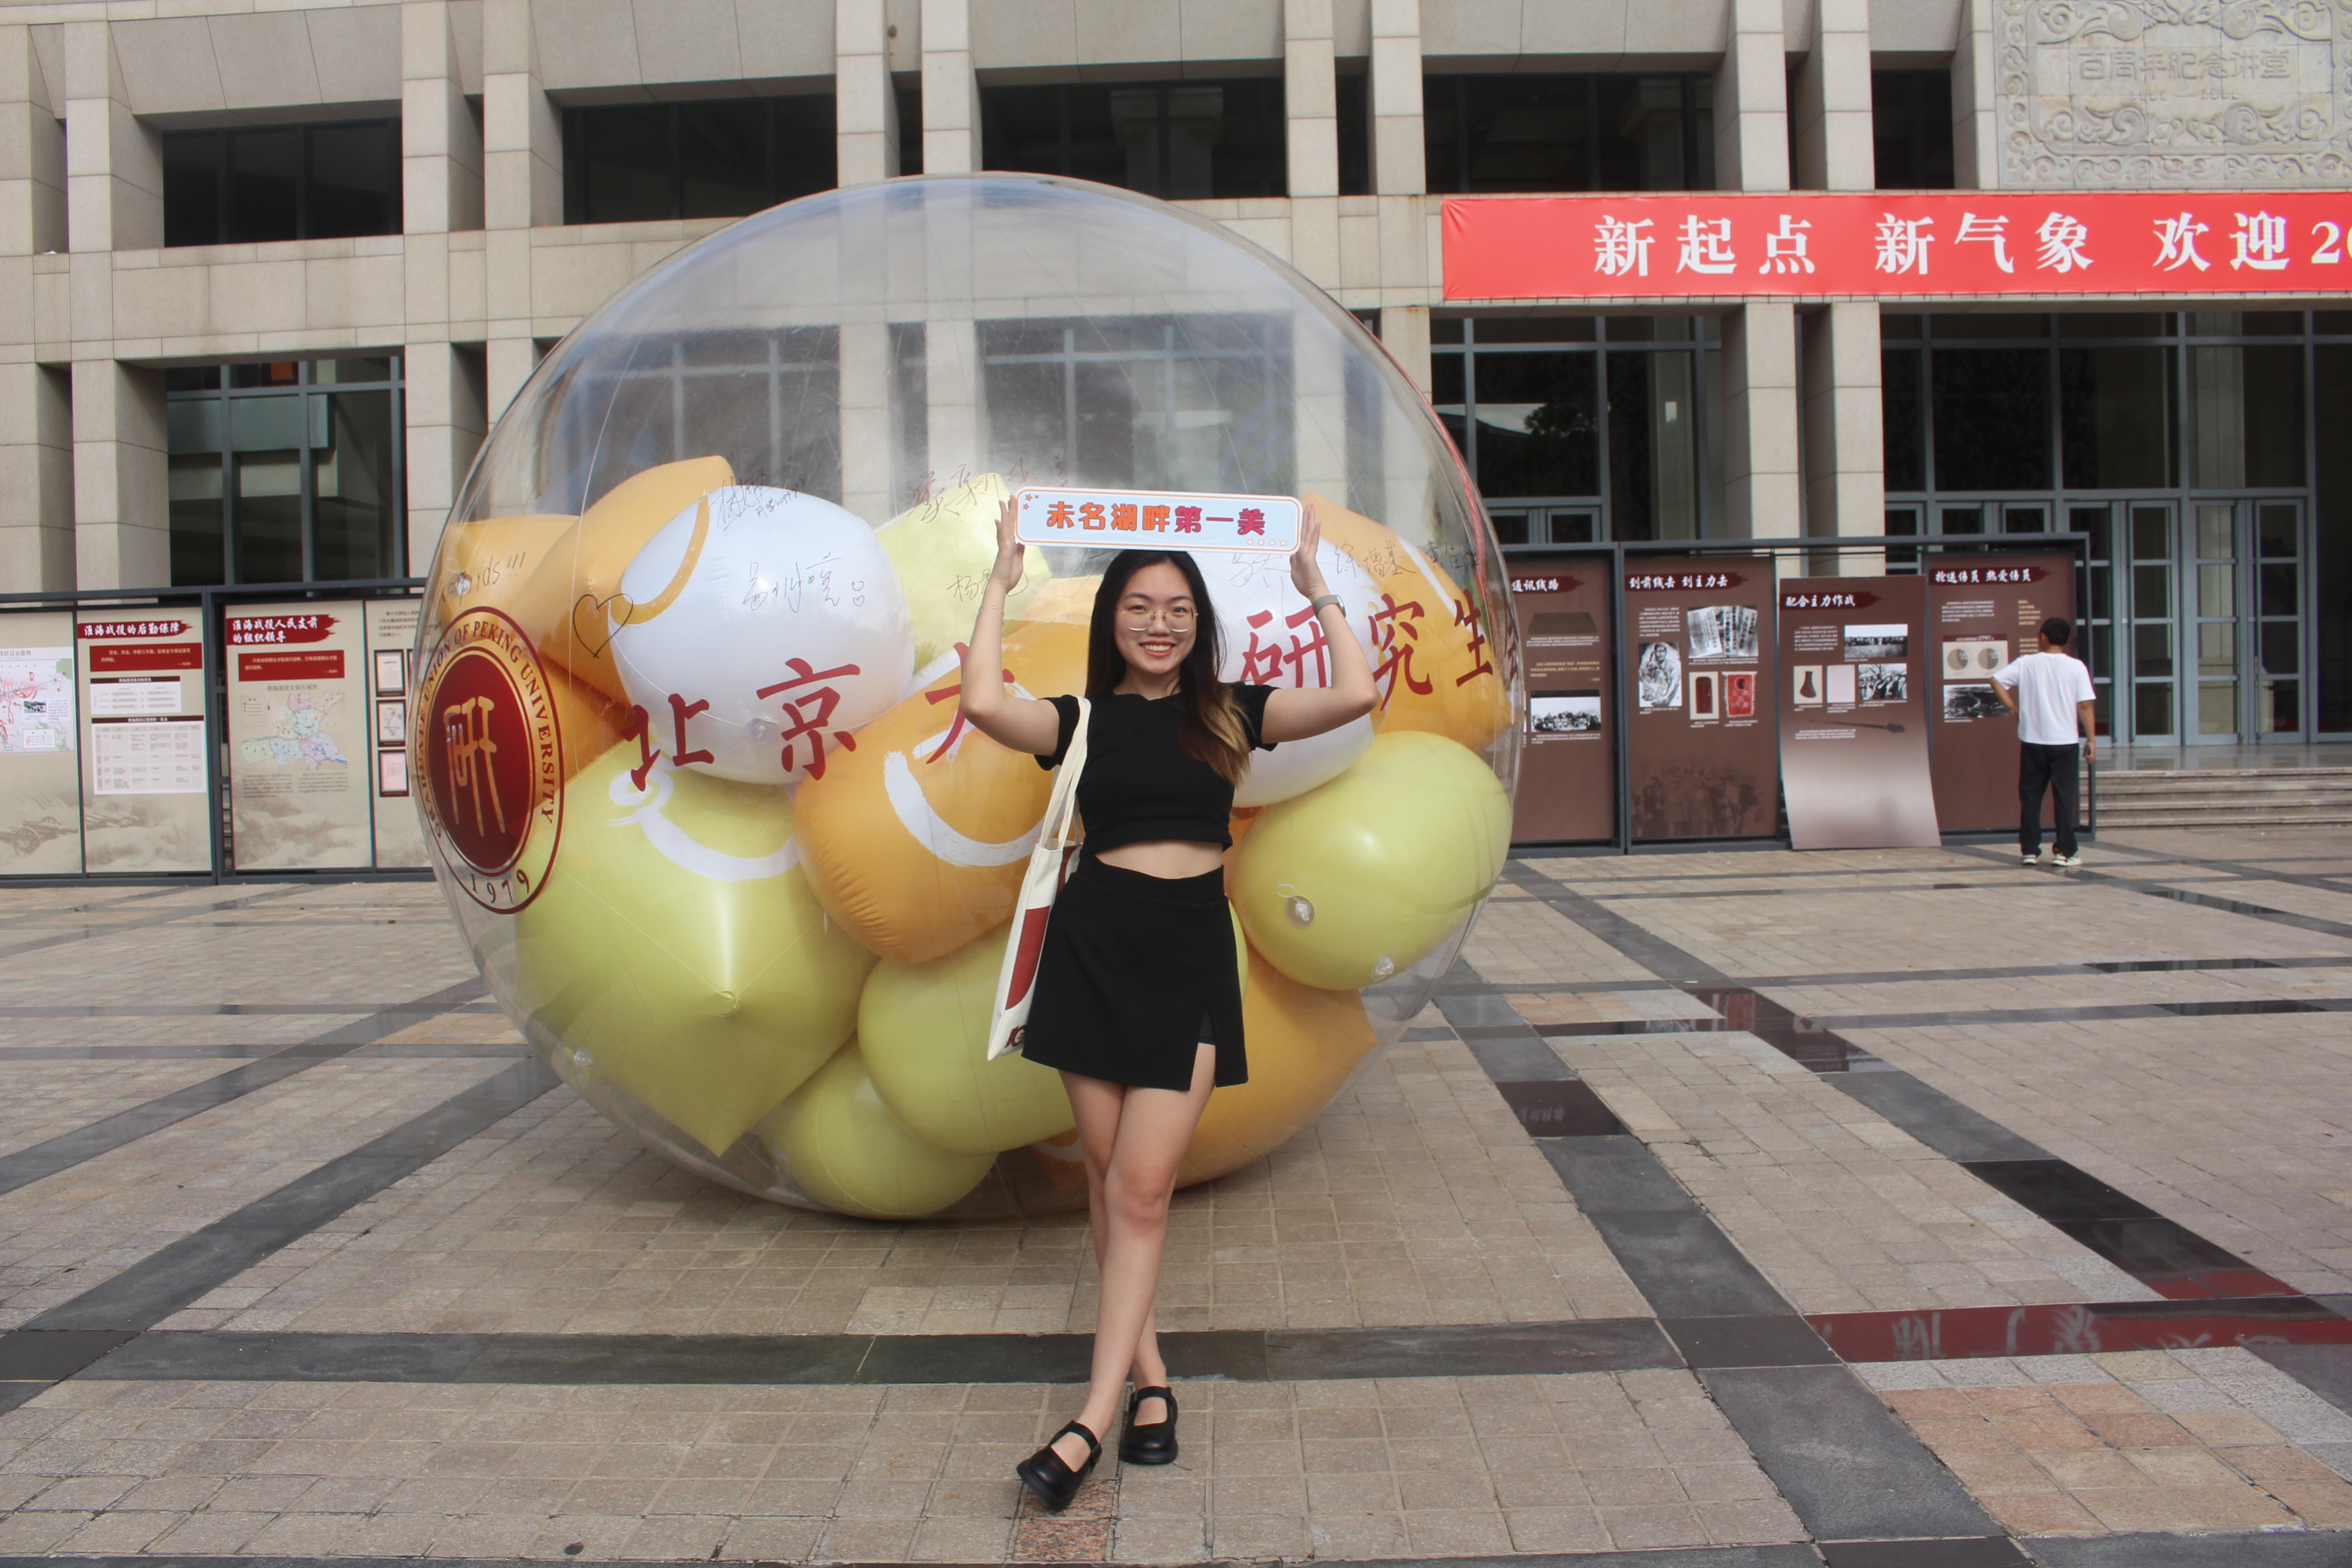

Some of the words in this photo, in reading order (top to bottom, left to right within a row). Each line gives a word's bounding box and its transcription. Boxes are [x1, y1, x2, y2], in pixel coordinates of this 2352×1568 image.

[1594, 214, 1815, 276] 新起点
[1875, 211, 2094, 275] 新气象
[1046, 501, 1265, 536] 未名湖畔第一美
[1629, 575, 1676, 590] 到前线去
[1681, 574, 1728, 588] 到主力去
[1785, 594, 1856, 608] 配合主力作战
[84, 622, 180, 636] 淮海战役的后勤保障
[232, 616, 318, 631] 淮海战役人民支前
[232, 630, 287, 643] 的组织领导
[423, 638, 451, 702] UNION
[454, 623, 470, 645] OF
[473, 621, 522, 663] PEKING
[520, 661, 555, 824] UNIVERSITY
[470, 869, 530, 904] 1979
